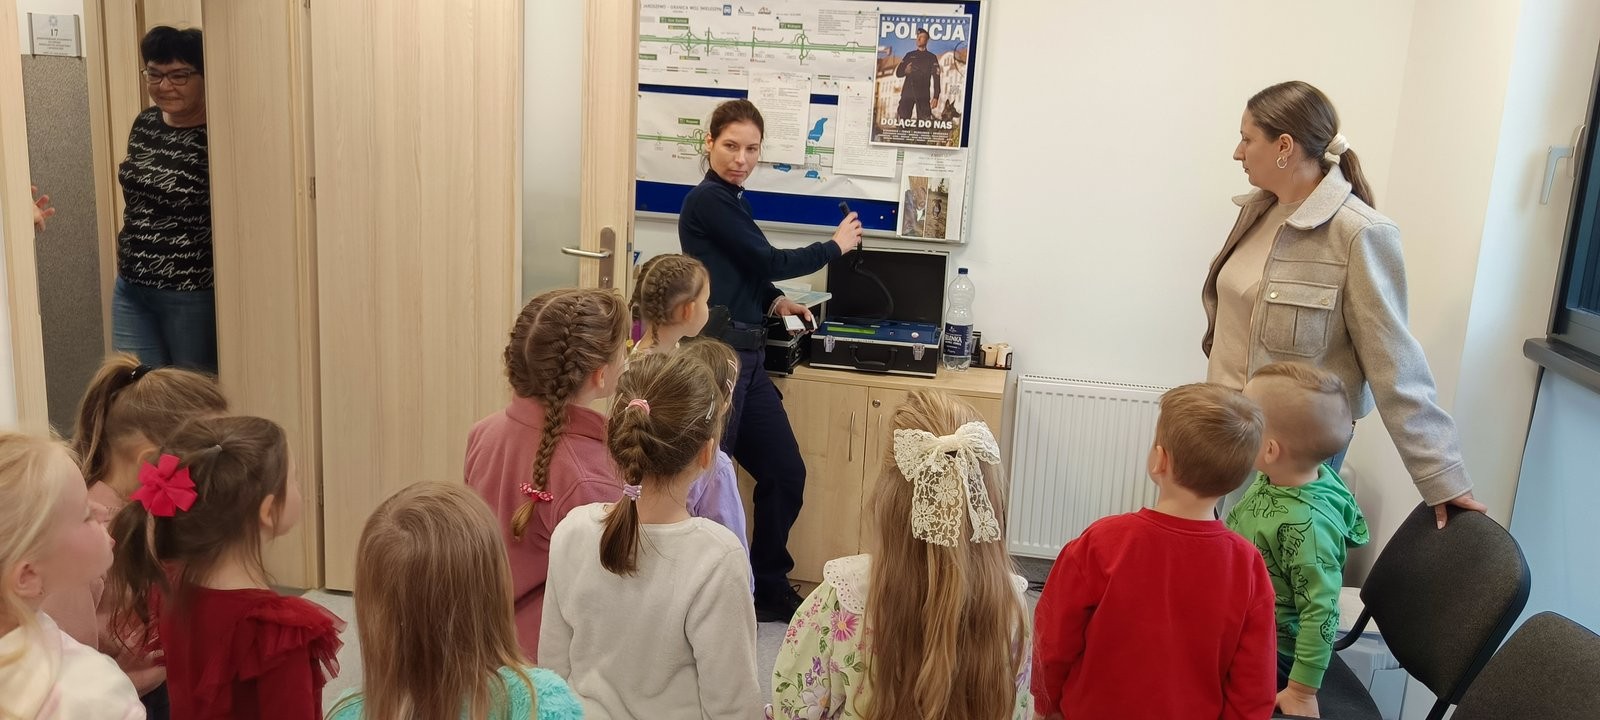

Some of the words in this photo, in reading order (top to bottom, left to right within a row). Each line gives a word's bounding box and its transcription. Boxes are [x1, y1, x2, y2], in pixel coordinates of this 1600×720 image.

[51, 28, 59, 37] 17
[881, 118, 916, 128] DOŁĄCZ
[918, 119, 931, 128] DO
[933, 120, 953, 130] NAS
